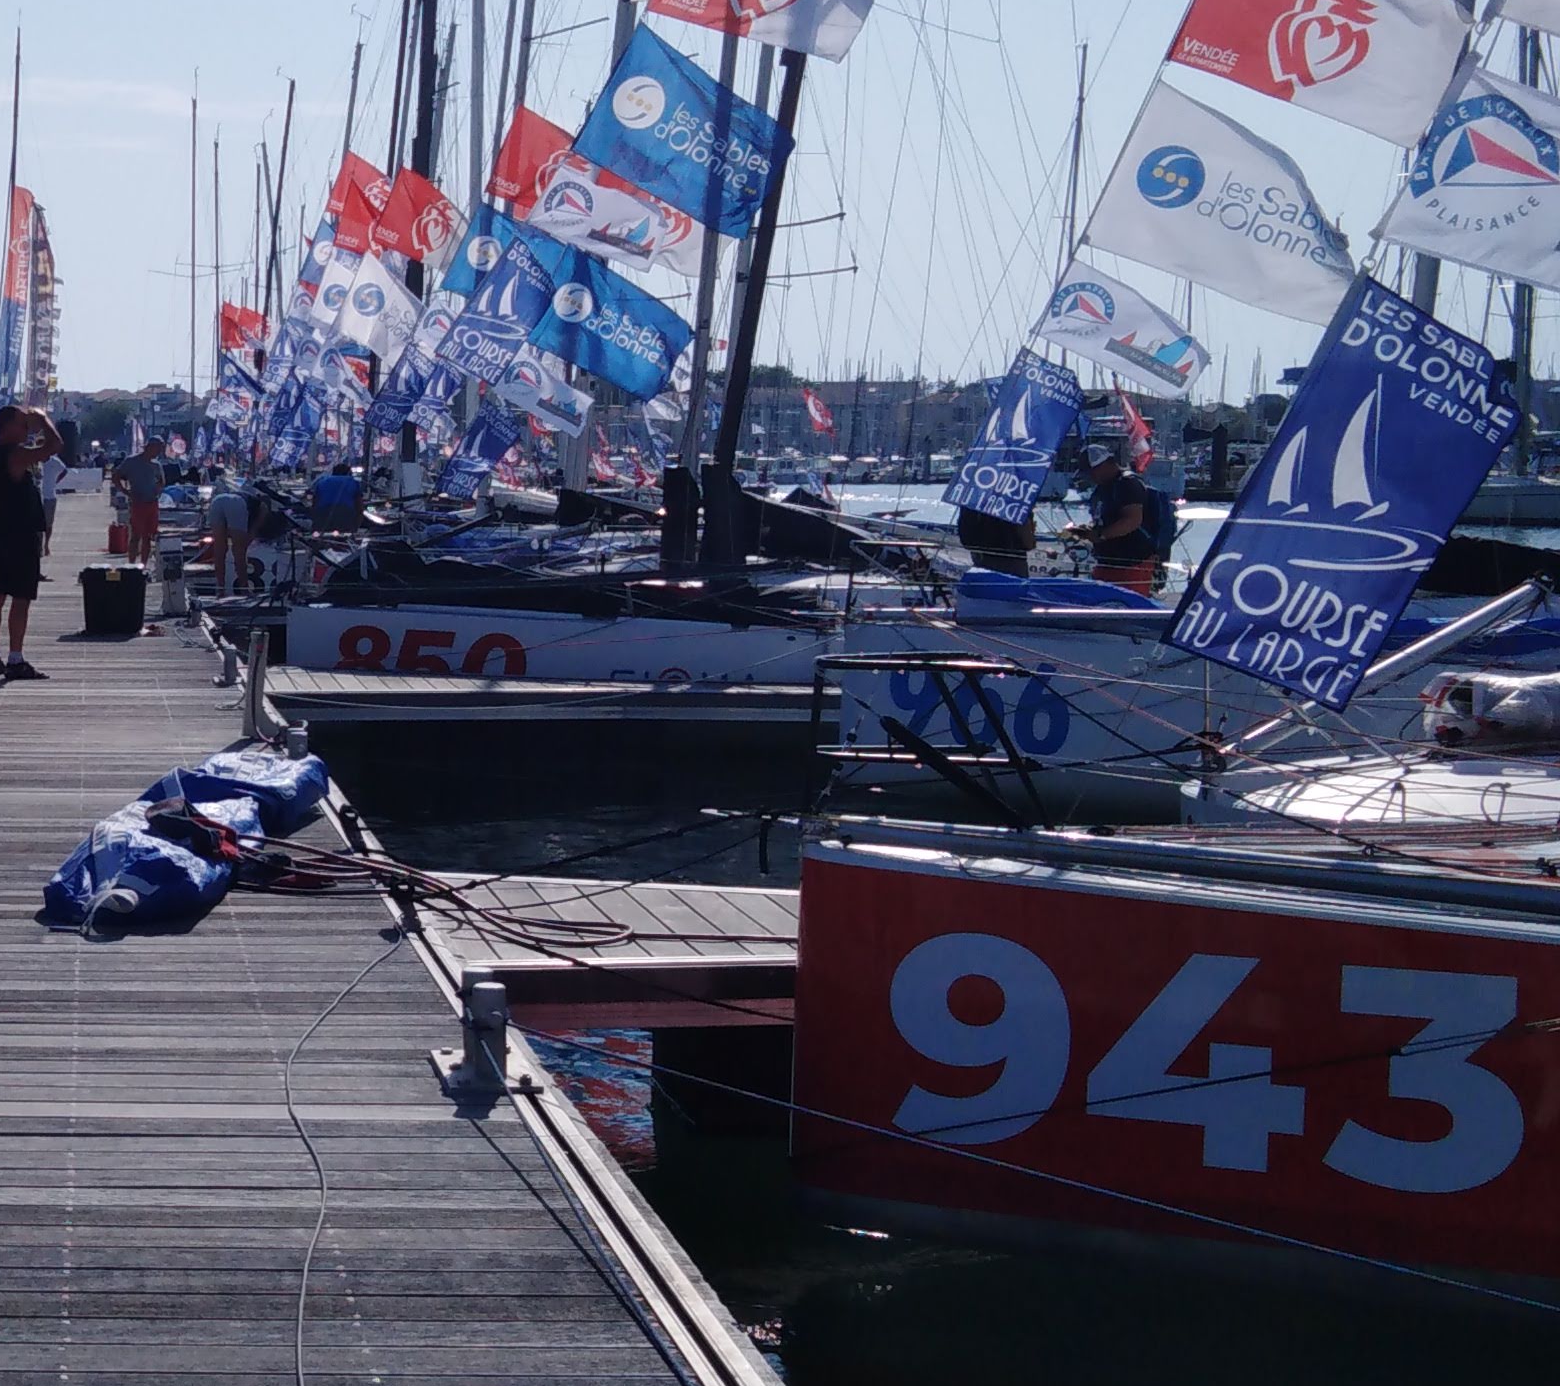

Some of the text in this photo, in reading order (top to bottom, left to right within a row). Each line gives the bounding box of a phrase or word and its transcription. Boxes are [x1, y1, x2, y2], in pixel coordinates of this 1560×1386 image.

[1182, 36, 1240, 66] VENDÉE
[654, 120, 748, 189] d'Olonne
[672, 101, 772, 175] les Sables
[1219, 170, 1256, 204] les
[1425, 195, 1540, 232] PLAISANCE
[1196, 196, 1327, 264] d'Olonne
[453, 325, 514, 369] COURSE
[585, 316, 659, 364] d'Olonne
[600, 303, 666, 351] les Sable
[1360, 289, 1490, 380] LES SABL
[440, 340, 461, 359] AU
[460, 351, 503, 385] LARGE
[1341, 317, 1514, 428] D'OLONNE
[1409, 382, 1501, 444] VENDÉE
[961, 463, 1039, 505] COURSE
[975, 490, 1029, 525] LARGE
[1203, 552, 1389, 658] COURSE
[333, 624, 527, 677] 850
[1172, 600, 1359, 703] AU LARGE
[889, 931, 1525, 1195] 943
